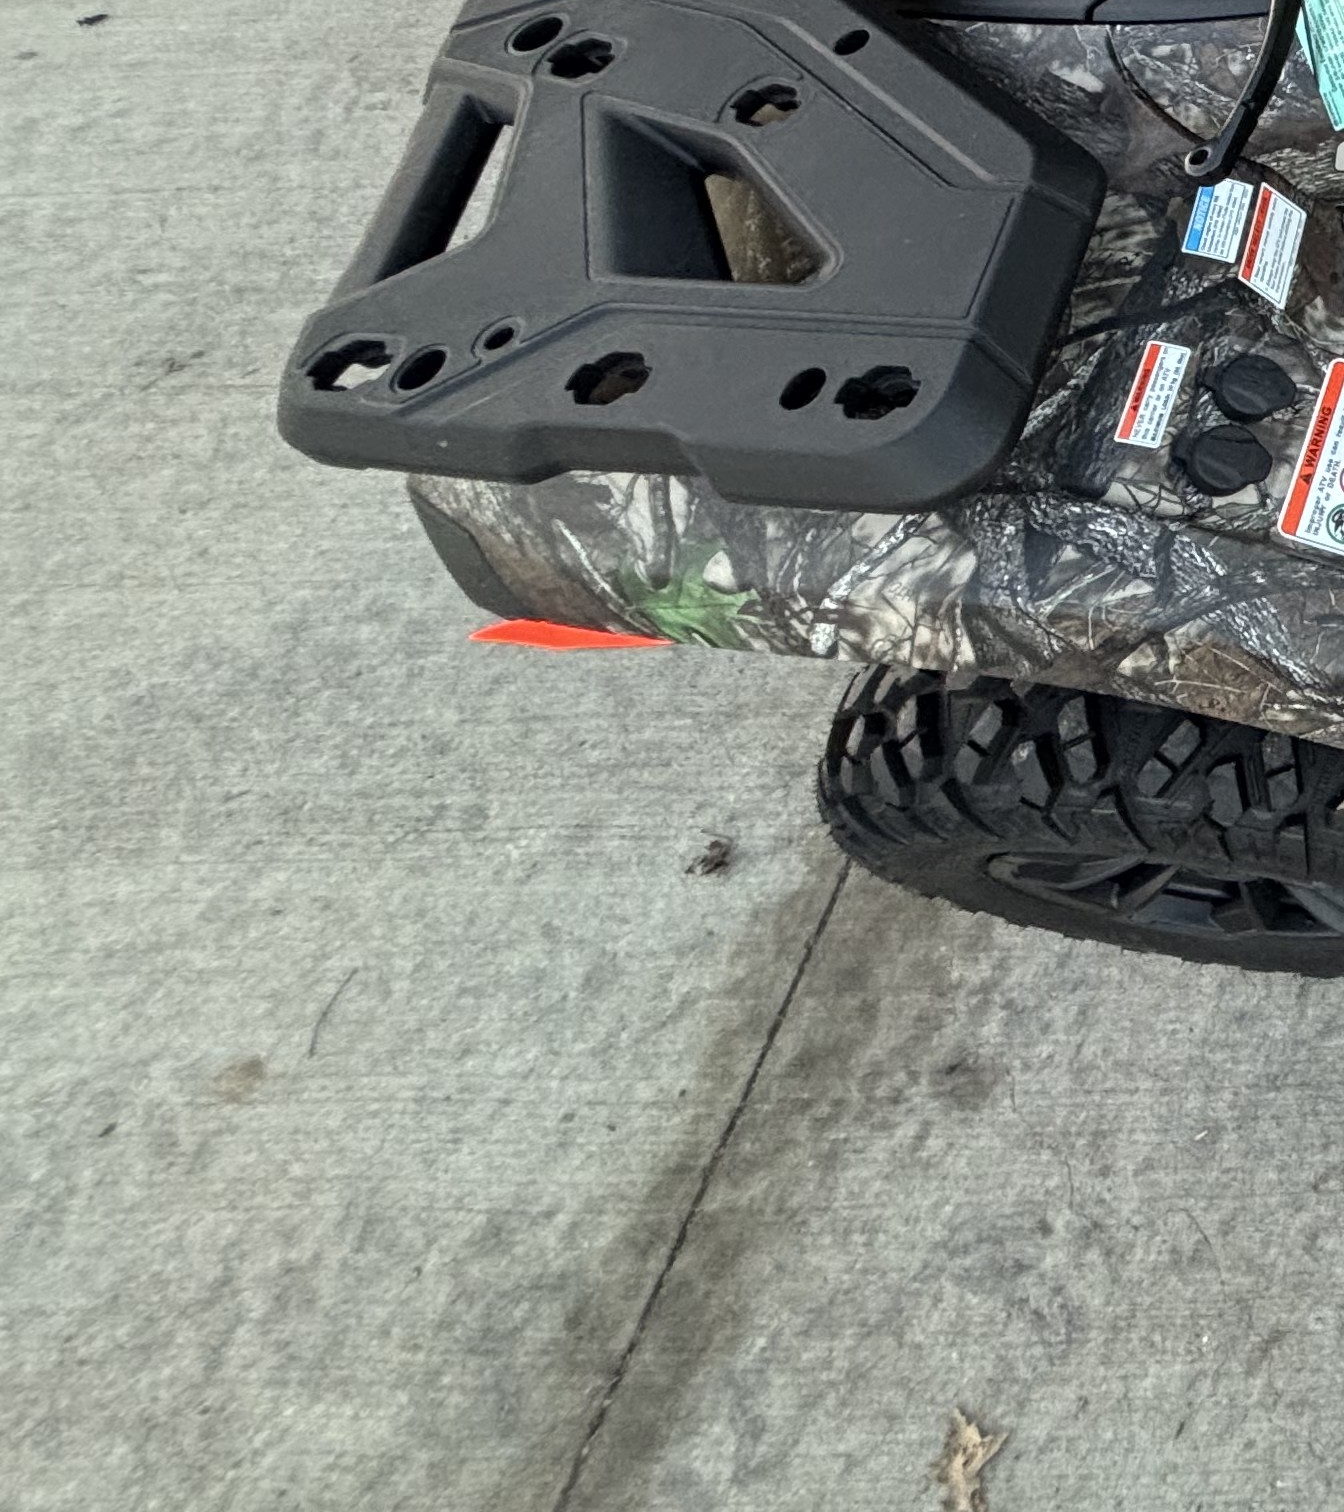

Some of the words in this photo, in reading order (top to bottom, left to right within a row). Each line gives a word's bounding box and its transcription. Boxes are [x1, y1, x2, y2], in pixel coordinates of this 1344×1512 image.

[1192, 195, 1210, 231] NOTICE
[1304, 406, 1332, 467] WARNING
[1305, 495, 1322, 533] Improper
[1317, 475, 1327, 492] ATV
[1325, 457, 1333, 473] use
[1330, 439, 1339, 456] can
[1326, 457, 1341, 488] DEATH.
[1324, 491, 1331, 501] or
[1311, 503, 1327, 536] INJURY
